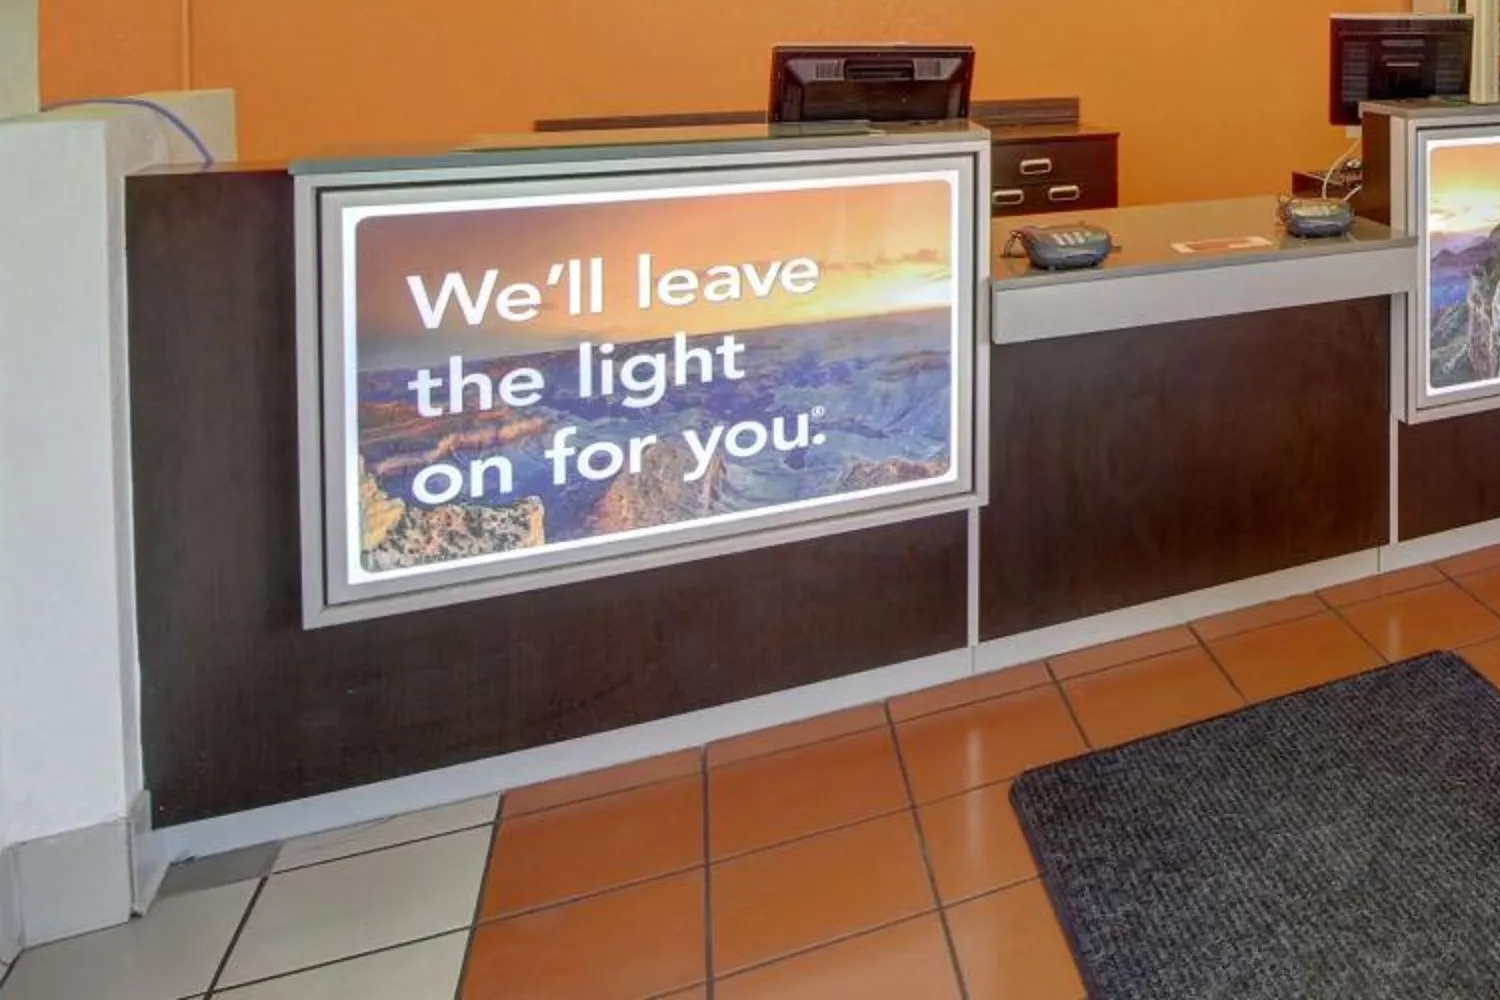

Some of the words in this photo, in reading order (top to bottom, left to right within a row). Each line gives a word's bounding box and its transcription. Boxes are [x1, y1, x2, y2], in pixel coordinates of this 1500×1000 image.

[406, 257, 603, 330] We'll
[638, 253, 820, 309] leave
[406, 356, 545, 418] the
[578, 333, 746, 408] light
[411, 456, 513, 505] on
[544, 426, 650, 486] for
